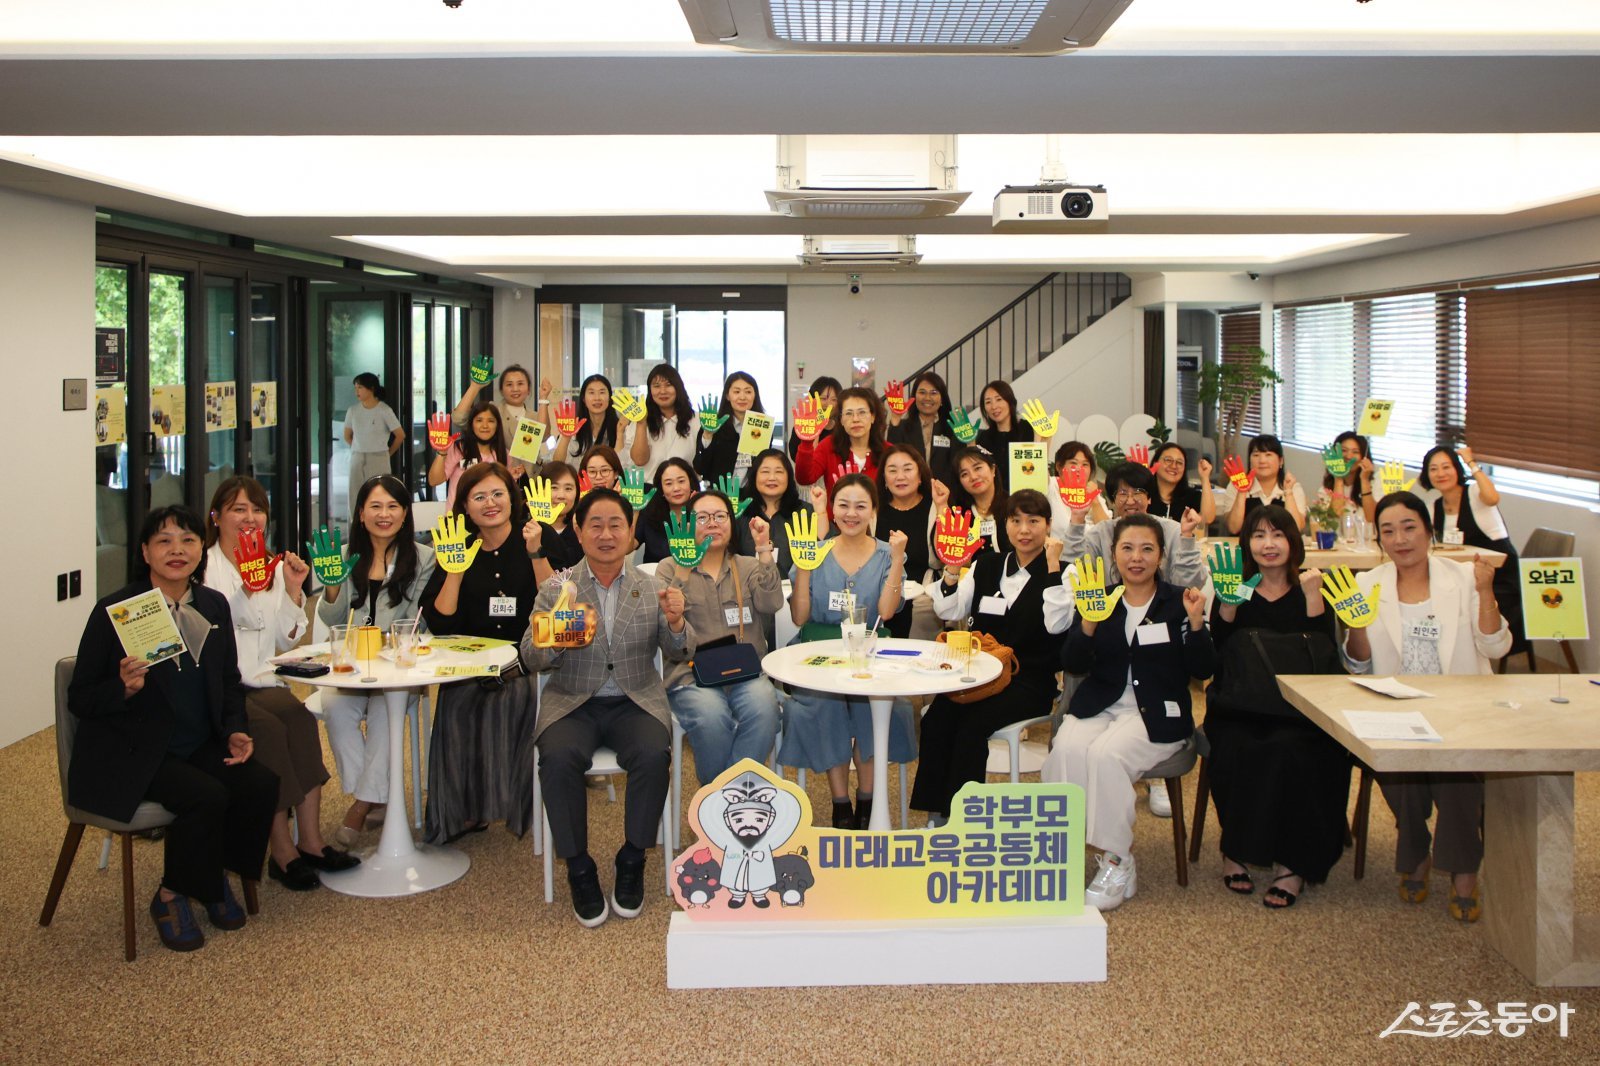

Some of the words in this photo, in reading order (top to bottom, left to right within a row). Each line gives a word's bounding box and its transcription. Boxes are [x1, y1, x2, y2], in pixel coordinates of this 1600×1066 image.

[622, 401, 639, 415] 학부모
[631, 406, 643, 418] 시장
[700, 412, 717, 420] 학부모
[704, 419, 717, 428] 시장
[794, 419, 816, 427] 학부모
[1031, 417, 1049, 427] 학부모
[562, 424, 575, 432] 시장
[800, 426, 816, 435] 시장
[1040, 423, 1053, 432] 시장
[429, 430, 449, 438] 학부모
[434, 437, 448, 445] 시장
[1014, 449, 1043, 459] 광동고
[621, 488, 644, 496] 학부모
[1060, 488, 1086, 496] 학부모
[629, 495, 643, 504] 시장
[1068, 494, 1085, 503] 시장
[529, 500, 551, 510] 학부모
[536, 509, 551, 518] 시장
[669, 538, 696, 548] 학부모
[790, 540, 816, 550] 학부모
[938, 534, 966, 547] 학부모
[437, 543, 465, 553] 학부모
[678, 547, 697, 559] 시장
[944, 546, 965, 558] 시장
[313, 555, 342, 567] 학부모
[446, 554, 465, 564] 시장
[798, 551, 816, 561] 시장
[240, 558, 266, 573] 학부모
[323, 565, 343, 577] 시장
[249, 570, 266, 583] 시장
[1212, 573, 1242, 584] 학부모
[1529, 569, 1575, 584] 오남고
[1076, 589, 1104, 600] 학부모
[1086, 600, 1106, 611] 시장
[1334, 592, 1365, 611] 학부모
[554, 610, 585, 621] 학부모
[1350, 603, 1371, 619] 시장
[564, 621, 585, 632] 시장
[1413, 627, 1438, 637] 최인주
[554, 632, 586, 644] 화이팅
[963, 794, 1069, 830] 학부모
[819, 832, 1068, 869] 미래교육공동체
[927, 868, 1068, 904] 아카데미
